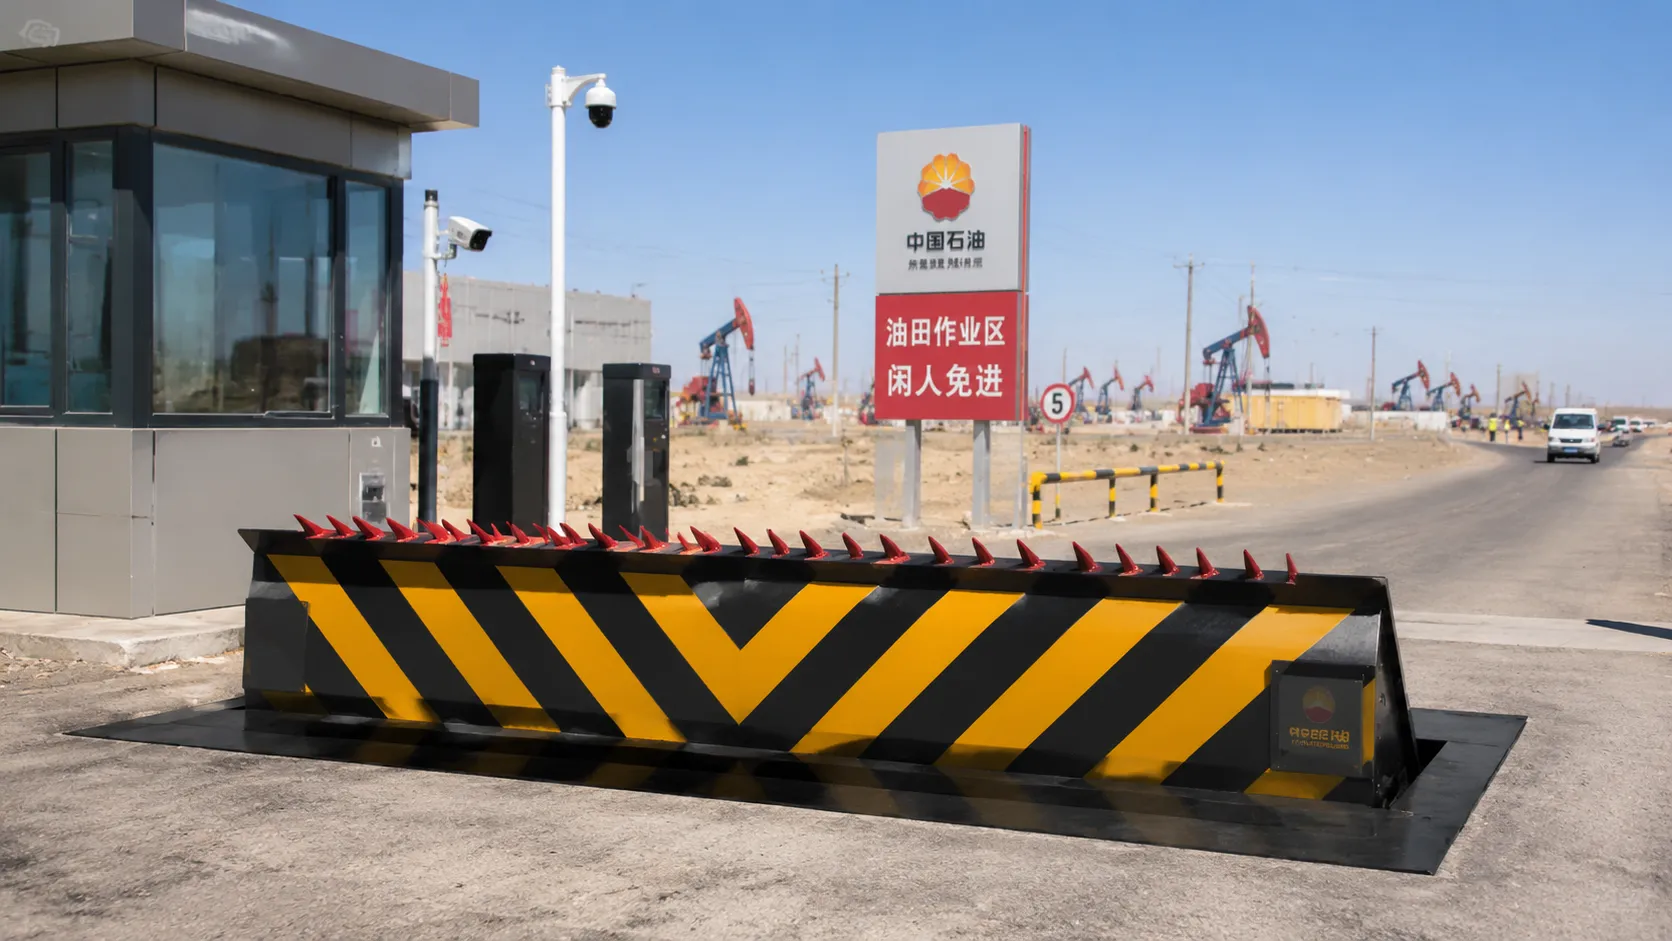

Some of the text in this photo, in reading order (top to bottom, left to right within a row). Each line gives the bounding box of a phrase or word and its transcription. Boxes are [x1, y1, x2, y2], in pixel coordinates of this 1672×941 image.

[907, 230, 985, 253] 中国石油
[886, 316, 1005, 347] 油田作业区
[888, 363, 1003, 397] 闲人免进
[1052, 392, 1063, 414] 5
